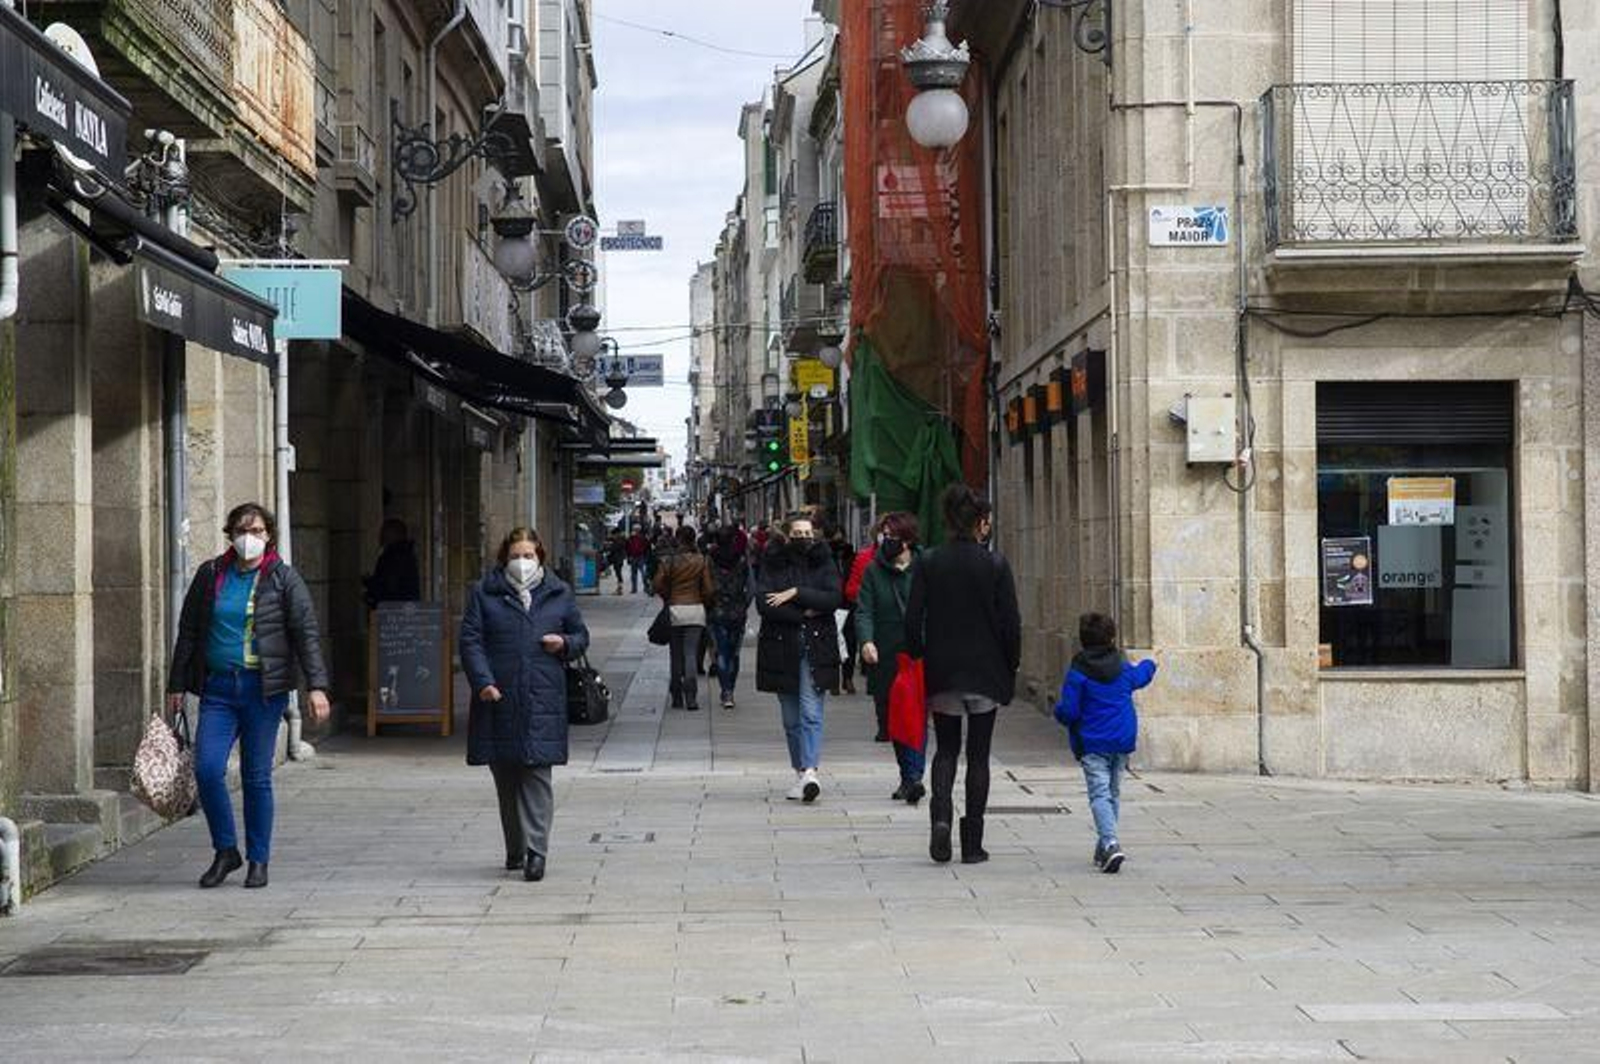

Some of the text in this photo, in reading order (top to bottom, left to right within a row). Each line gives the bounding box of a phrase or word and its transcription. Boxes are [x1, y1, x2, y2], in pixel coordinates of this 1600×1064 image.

[1177, 217, 1212, 228] PRAZA
[1169, 231, 1208, 242] MAIOR
[1382, 572, 1435, 586] orange
